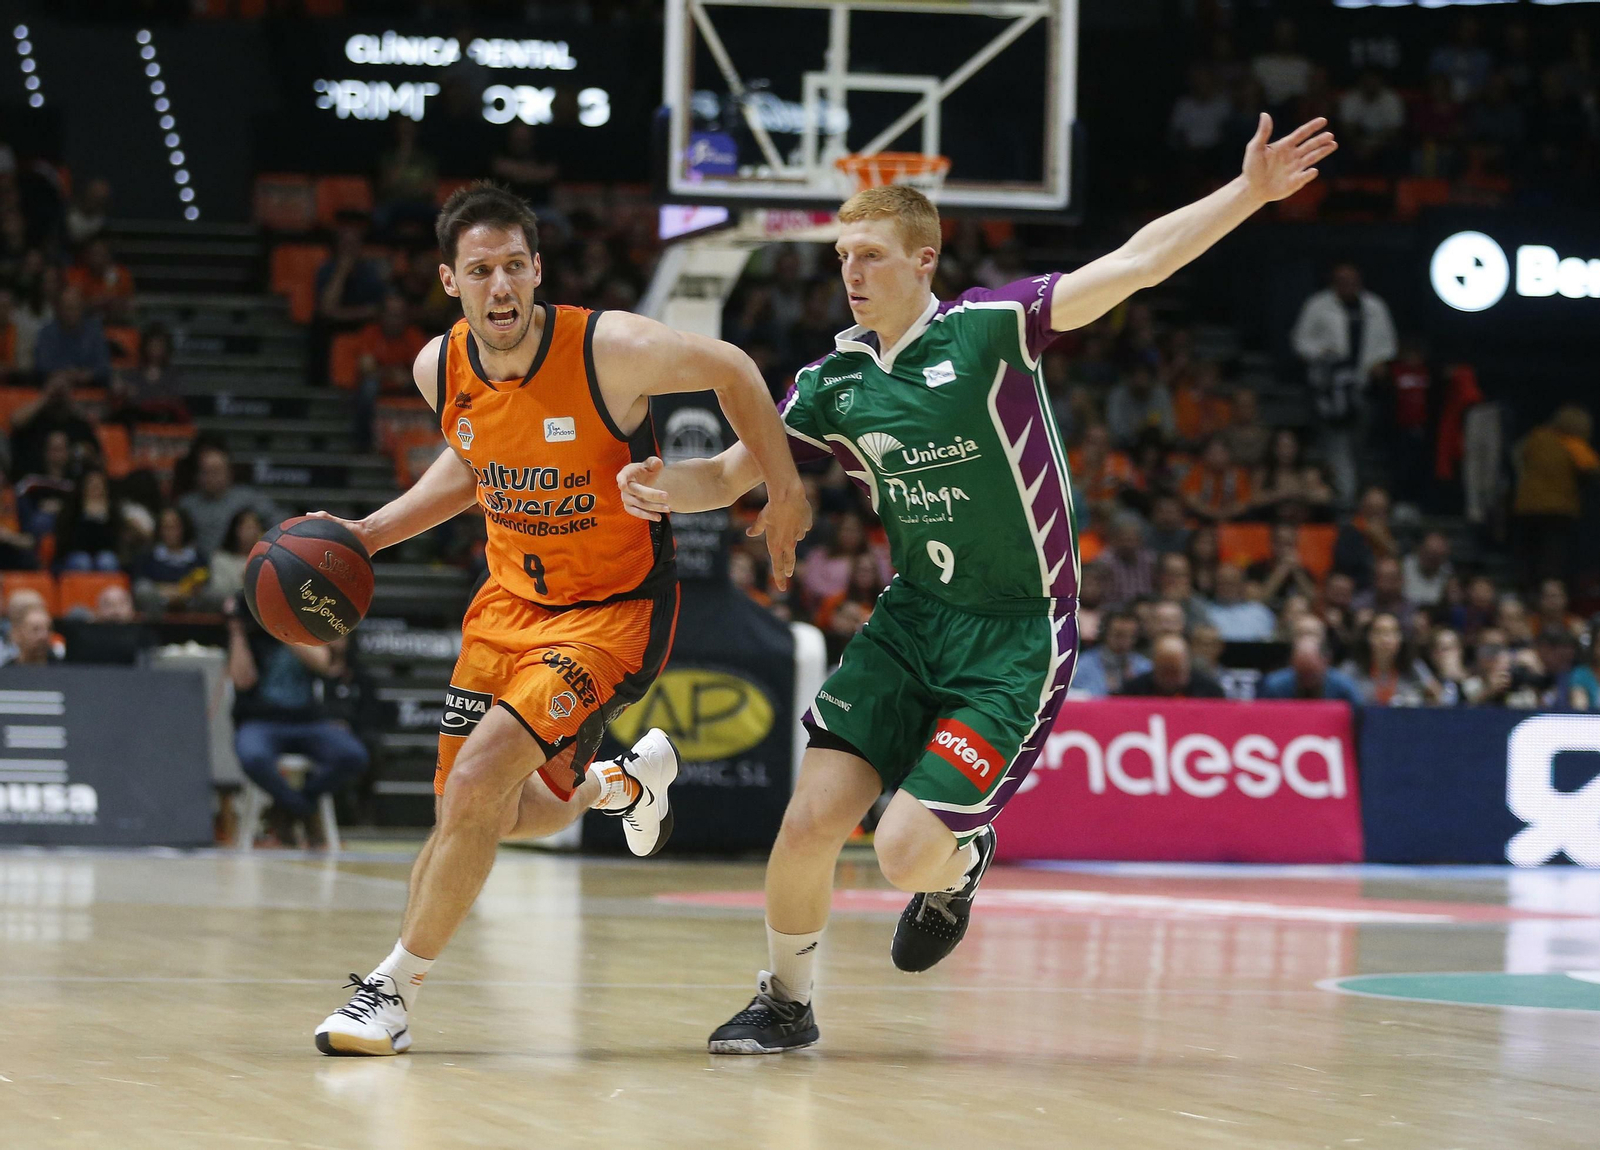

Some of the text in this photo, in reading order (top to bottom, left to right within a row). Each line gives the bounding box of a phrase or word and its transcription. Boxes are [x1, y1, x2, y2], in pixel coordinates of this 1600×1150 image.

[902, 436, 978, 465] Unicaja
[464, 457, 591, 492] ultura del
[523, 553, 549, 596] 9
[926, 539, 955, 585] 9
[445, 693, 487, 714] ULEVA
[633, 680, 750, 742] AP
[817, 690, 852, 712] SPALDING
[0, 782, 98, 814] usa
